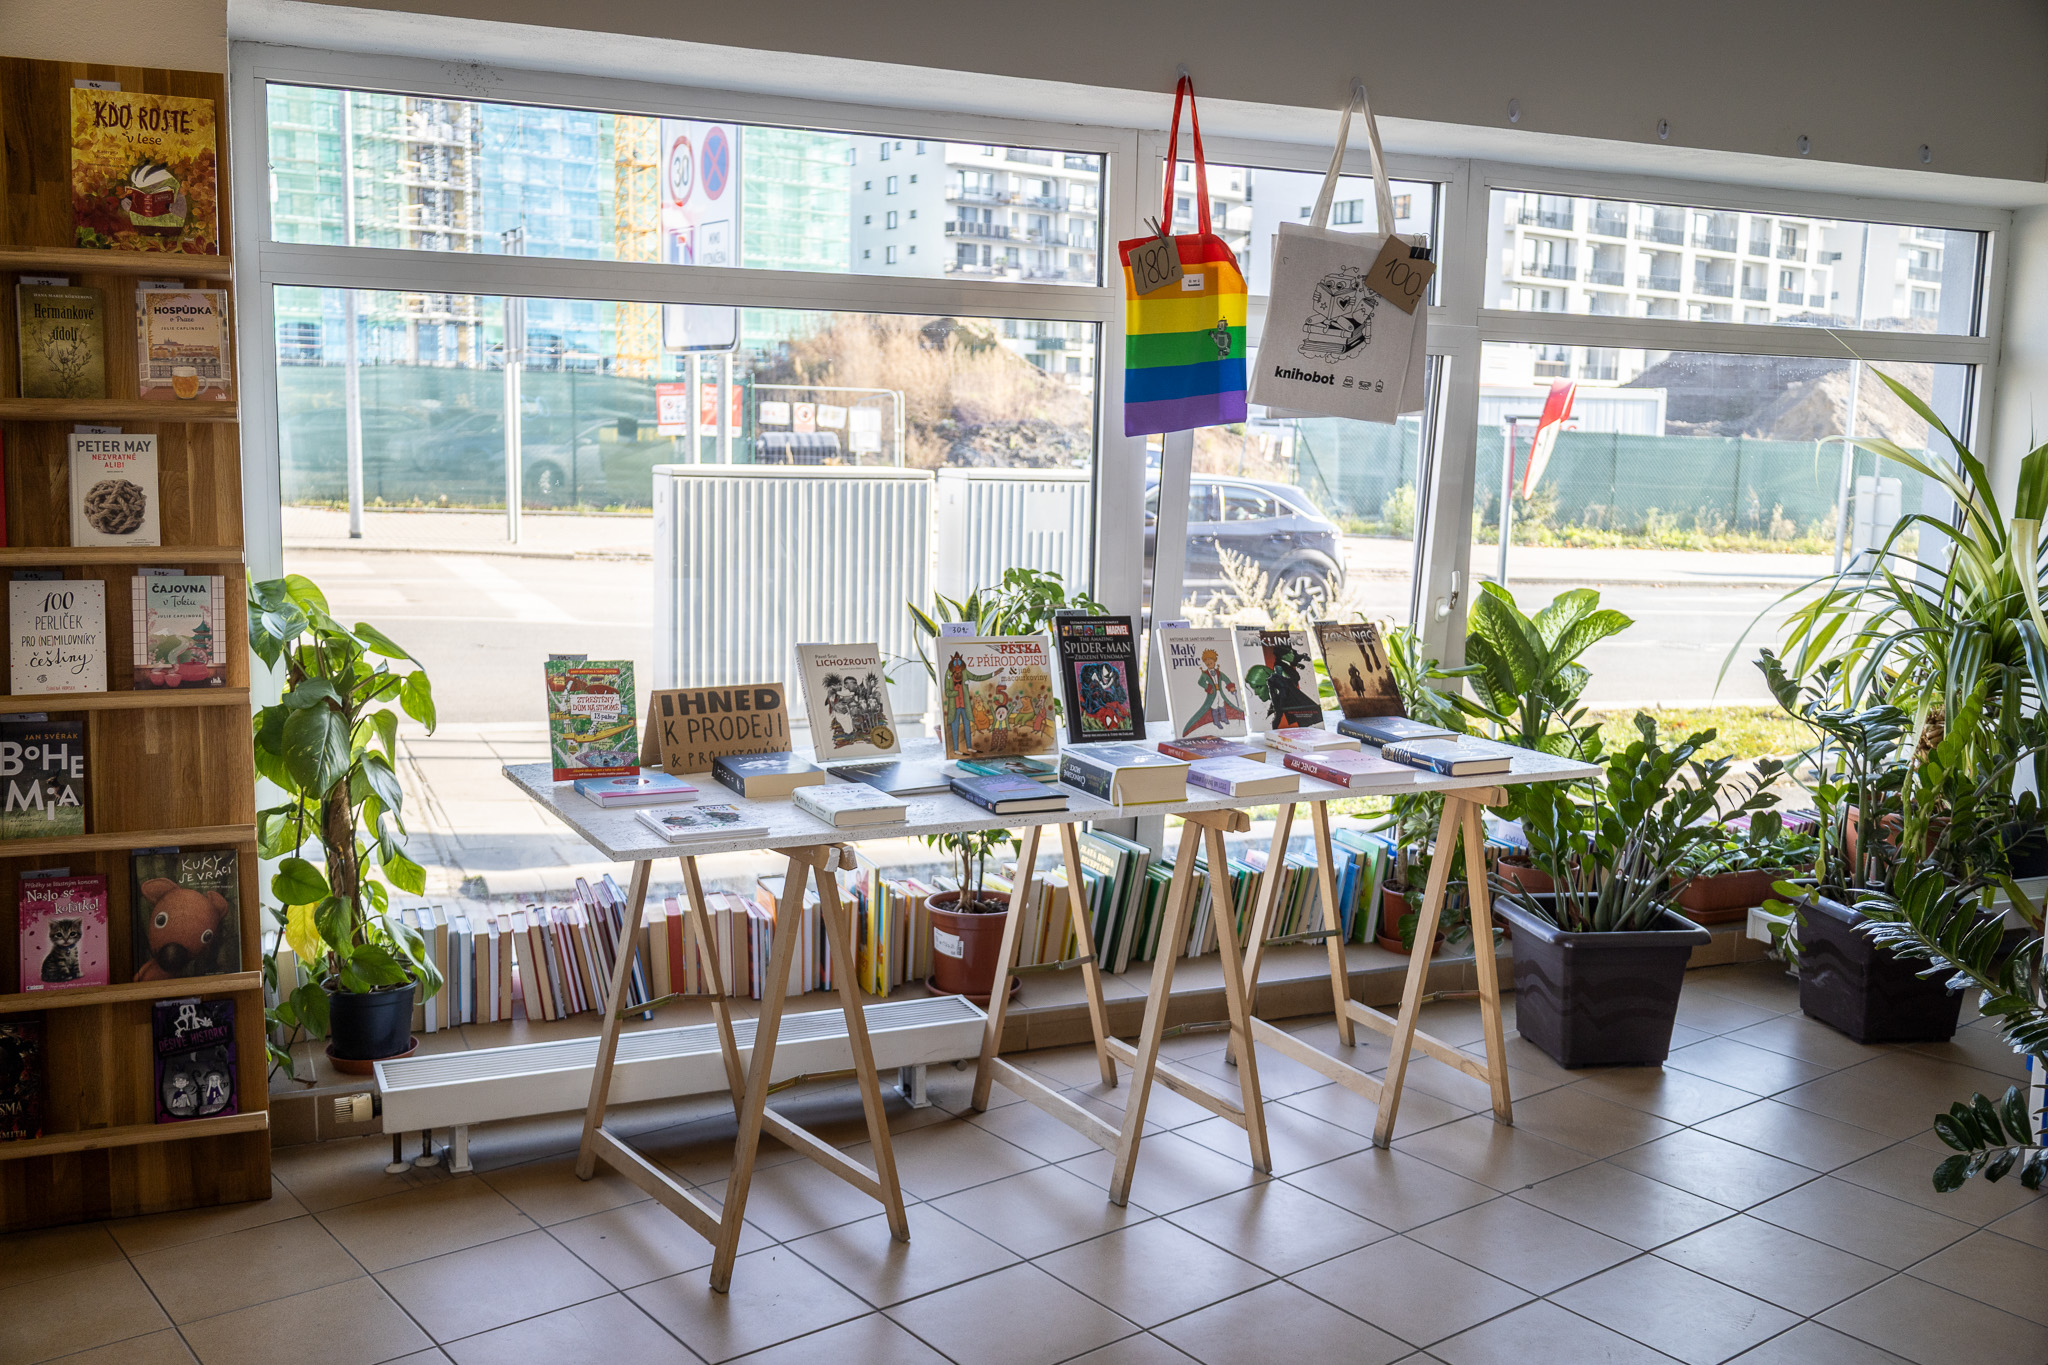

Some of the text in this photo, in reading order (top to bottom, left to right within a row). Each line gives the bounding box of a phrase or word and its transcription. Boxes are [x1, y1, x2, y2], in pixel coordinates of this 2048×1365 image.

[93, 101, 194, 134] KDO ROSTE
[126, 133, 162, 145] v lese
[674, 155, 690, 188] 30
[34, 303, 94, 320] Heřmánkové
[154, 304, 212, 314] HOSPŮDKA
[1274, 365, 1335, 385] knihobot
[77, 441, 151, 452] PETER MAY
[152, 583, 206, 593] ČAJOVNA
[36, 591, 74, 612] 100
[171, 595, 196, 607] Tokiu
[35, 612, 83, 630] PERLIČEK
[1105, 625, 1129, 635] MARVEL
[21, 633, 96, 647] PRO (NE)MILOVNÍKY
[1064, 640, 1131, 653] SPIDER-MAN
[1243, 635, 1304, 647] ZAKLÍNAČ
[1000, 641, 1042, 654] PĚTKA
[1170, 643, 1196, 657] Malý
[29, 648, 93, 674] češtiny
[816, 657, 876, 667] LICHOŽROUTI
[967, 653, 1047, 667] Z PŘÍRODOPISU
[1172, 655, 1201, 669] princ
[1009, 666, 1017, 675] &
[994, 685, 1008, 706] 5
[661, 689, 780, 717] IHNED
[44, 732, 78, 740] SVĚRÁK
[664, 720, 679, 746] K
[687, 712, 783, 744] PRODEJI
[876, 731, 889, 744] X
[671, 753, 682, 768] &
[1301, 763, 1318, 773] KONEC
[181, 855, 222, 872] KUKY
[179, 859, 235, 884] SE VRACÍ
[26, 889, 74, 902] Našlo se
[54, 898, 99, 915] koťátko!
[191, 1024, 228, 1045] HISTORKY
